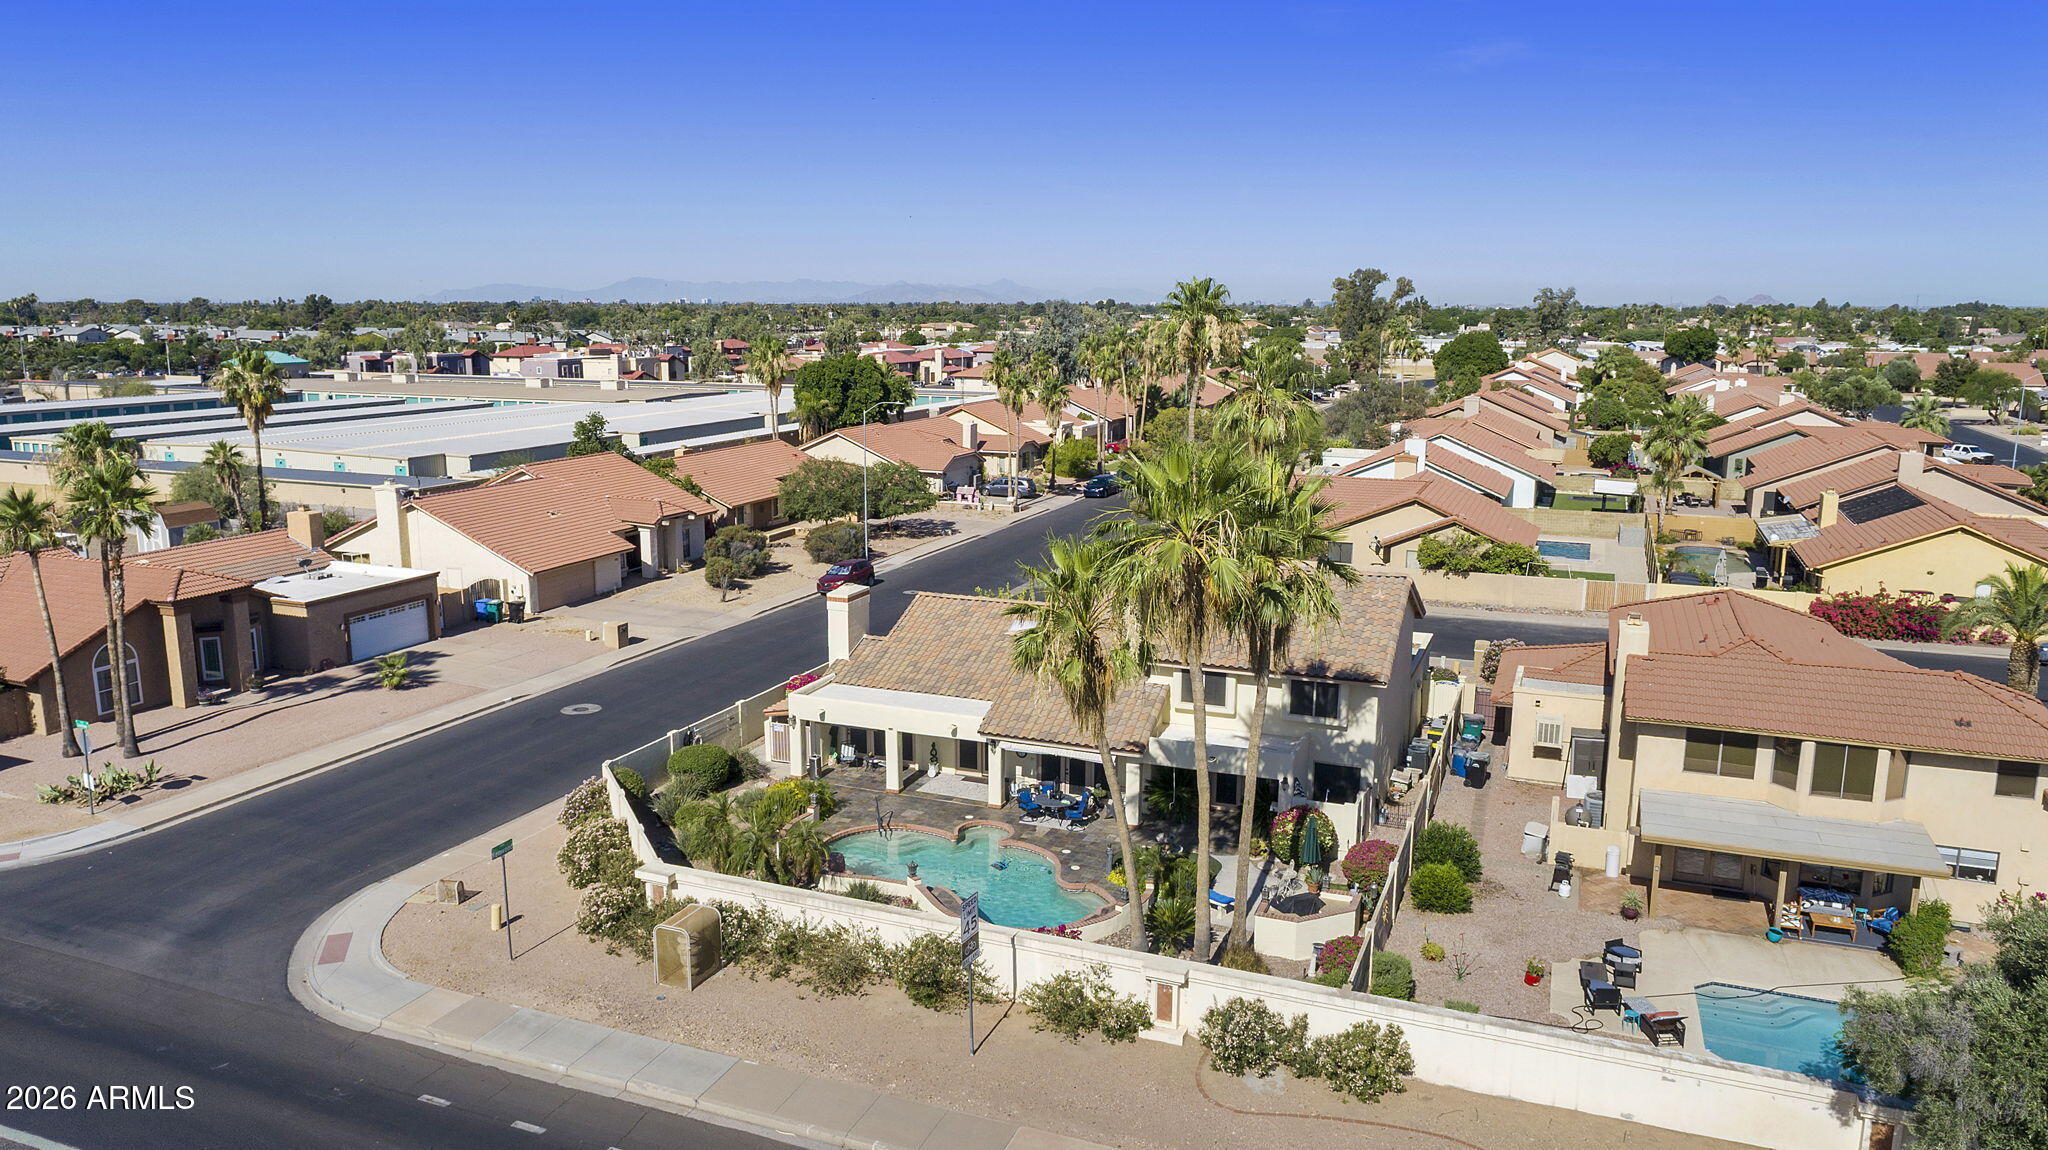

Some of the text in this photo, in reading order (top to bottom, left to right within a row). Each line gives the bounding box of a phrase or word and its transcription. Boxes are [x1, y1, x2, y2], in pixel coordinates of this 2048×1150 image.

[962, 896, 977, 911] SPEED
[963, 905, 976, 920] LIMIT
[963, 914, 977, 935] 45
